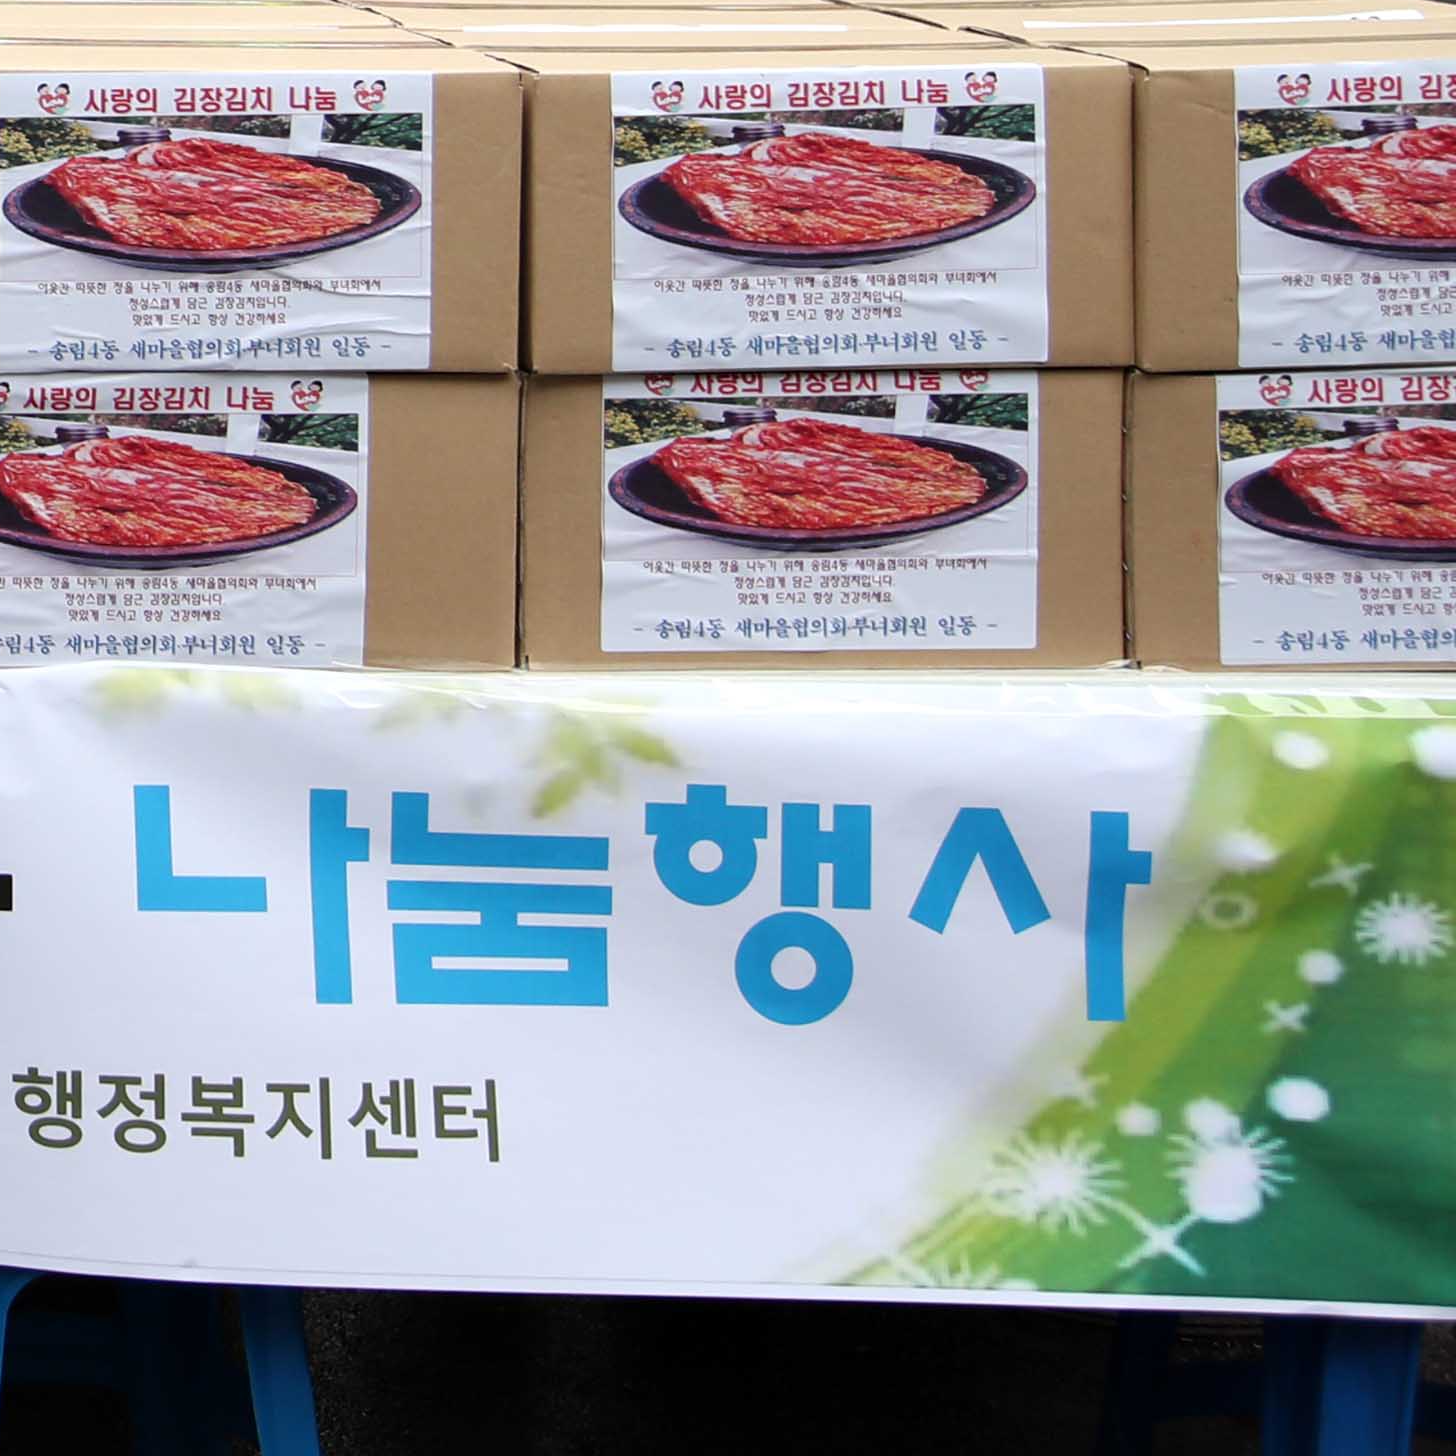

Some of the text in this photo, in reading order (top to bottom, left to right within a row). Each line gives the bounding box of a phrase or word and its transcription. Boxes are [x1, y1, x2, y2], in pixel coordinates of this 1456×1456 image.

[85, 86, 337, 113] 사랑의 김장김치 나눔
[699, 78, 949, 110] 사랑의 김장김치 나눔
[1327, 75, 1402, 103] 사랑의
[50, 341, 119, 362] 송림4동
[332, 338, 370, 359] 일동
[667, 337, 736, 360] 송림4동
[949, 331, 987, 353] 일동
[1295, 332, 1367, 355] 송림4동
[23, 385, 274, 411] 사랑의 김장김치 나눔
[1308, 377, 1384, 404] 사랑의
[655, 619, 725, 640] 송림4동
[938, 617, 976, 638] 일동
[1277, 631, 1349, 653] 송림4동
[267, 636, 305, 657] 일동
[133, 783, 1153, 1026] 나눔행사
[13, 1067, 499, 1162] 행정복지센터
